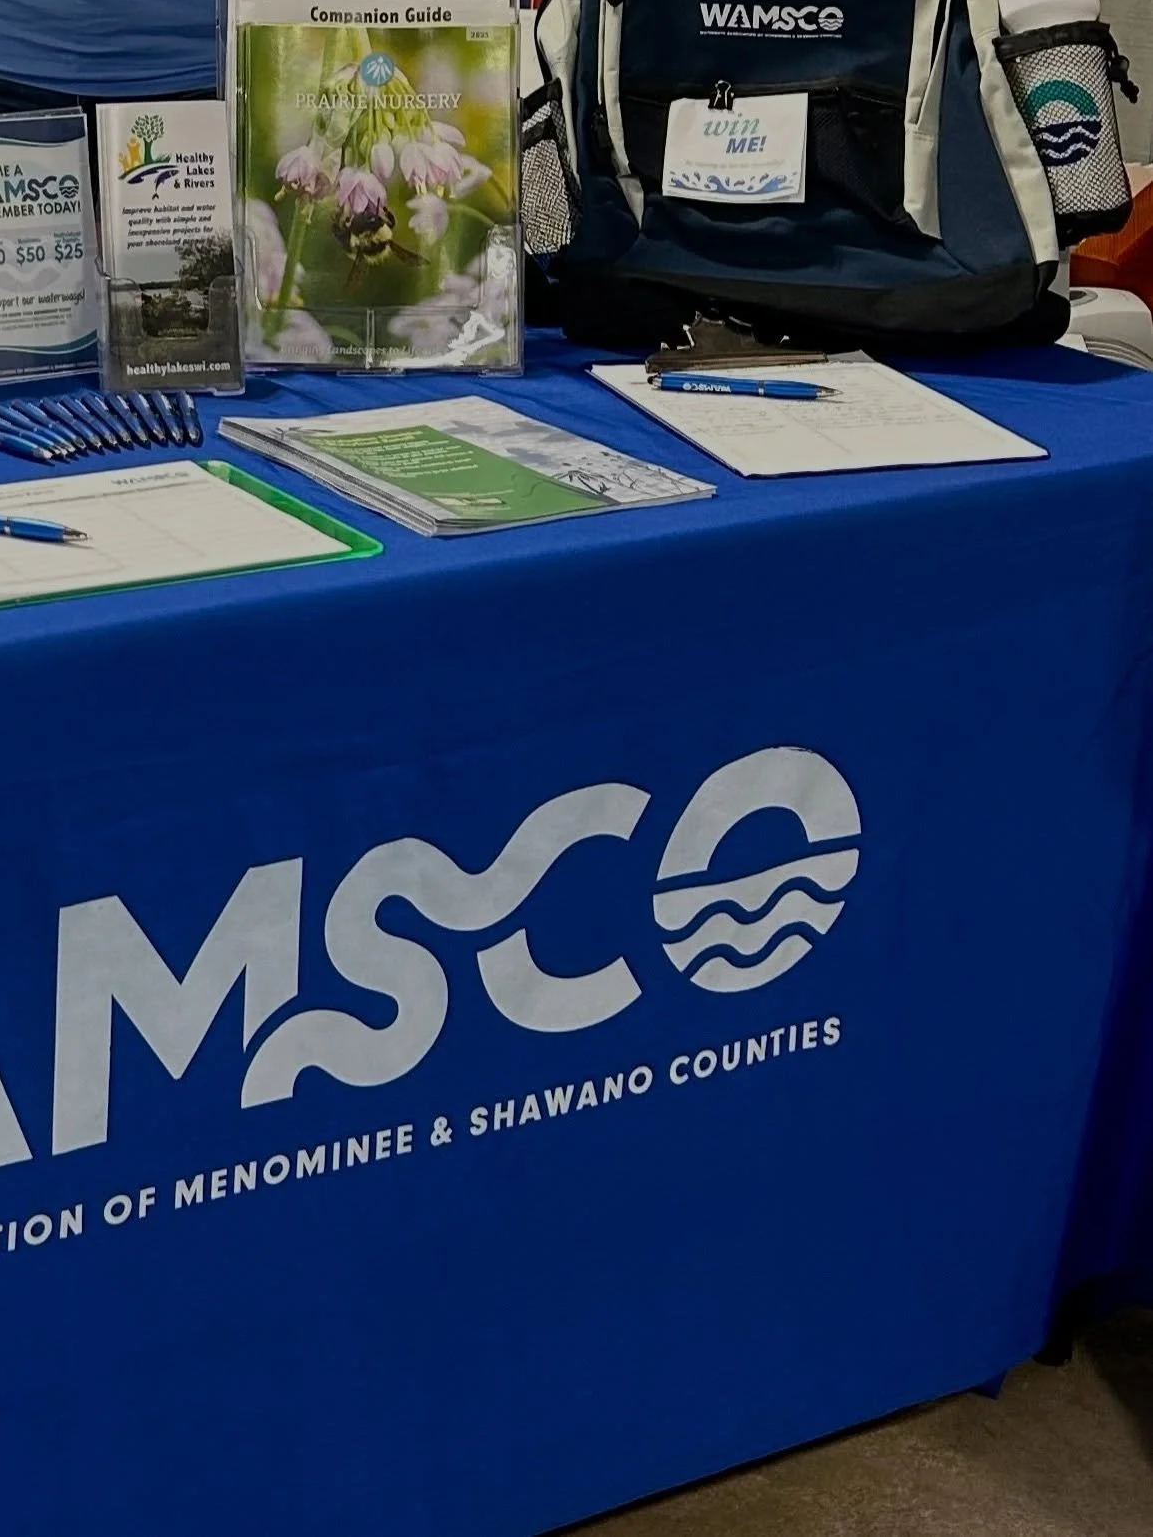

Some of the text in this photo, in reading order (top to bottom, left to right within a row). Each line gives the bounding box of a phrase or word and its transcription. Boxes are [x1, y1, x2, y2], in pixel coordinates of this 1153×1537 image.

[310, 6, 452, 24] Companion Guide
[700, 3, 844, 31] WAMSCO
[296, 92, 462, 109] PRAIRIE NURSERY
[703, 112, 760, 136] win
[726, 135, 767, 154] ME!
[176, 152, 214, 164] Healthy
[14, 164, 23, 177] A
[187, 165, 214, 176] Lakes
[174, 178, 214, 189] & Rivers
[39, 201, 81, 215] TODAY!
[122, 206, 152, 215] Improve
[128, 217, 153, 227] quality
[173, 215, 197, 223] simple
[199, 214, 211, 222] and
[128, 225, 213, 237] inexpensive projects for
[127, 241, 143, 249] your
[16, 245, 45, 267] $50
[54, 243, 83, 263] $25
[22, 296, 34, 305] our
[38, 288, 85, 306] waterways!
[127, 360, 231, 376] healthylakeswi.com
[101, 1187, 158, 1226] OF
[174, 1123, 415, 1209] MENOMINEE
[429, 1116, 453, 1147] &
[468, 1066, 653, 1137] SHAWANO
[669, 1014, 843, 1087] COUNTIES
